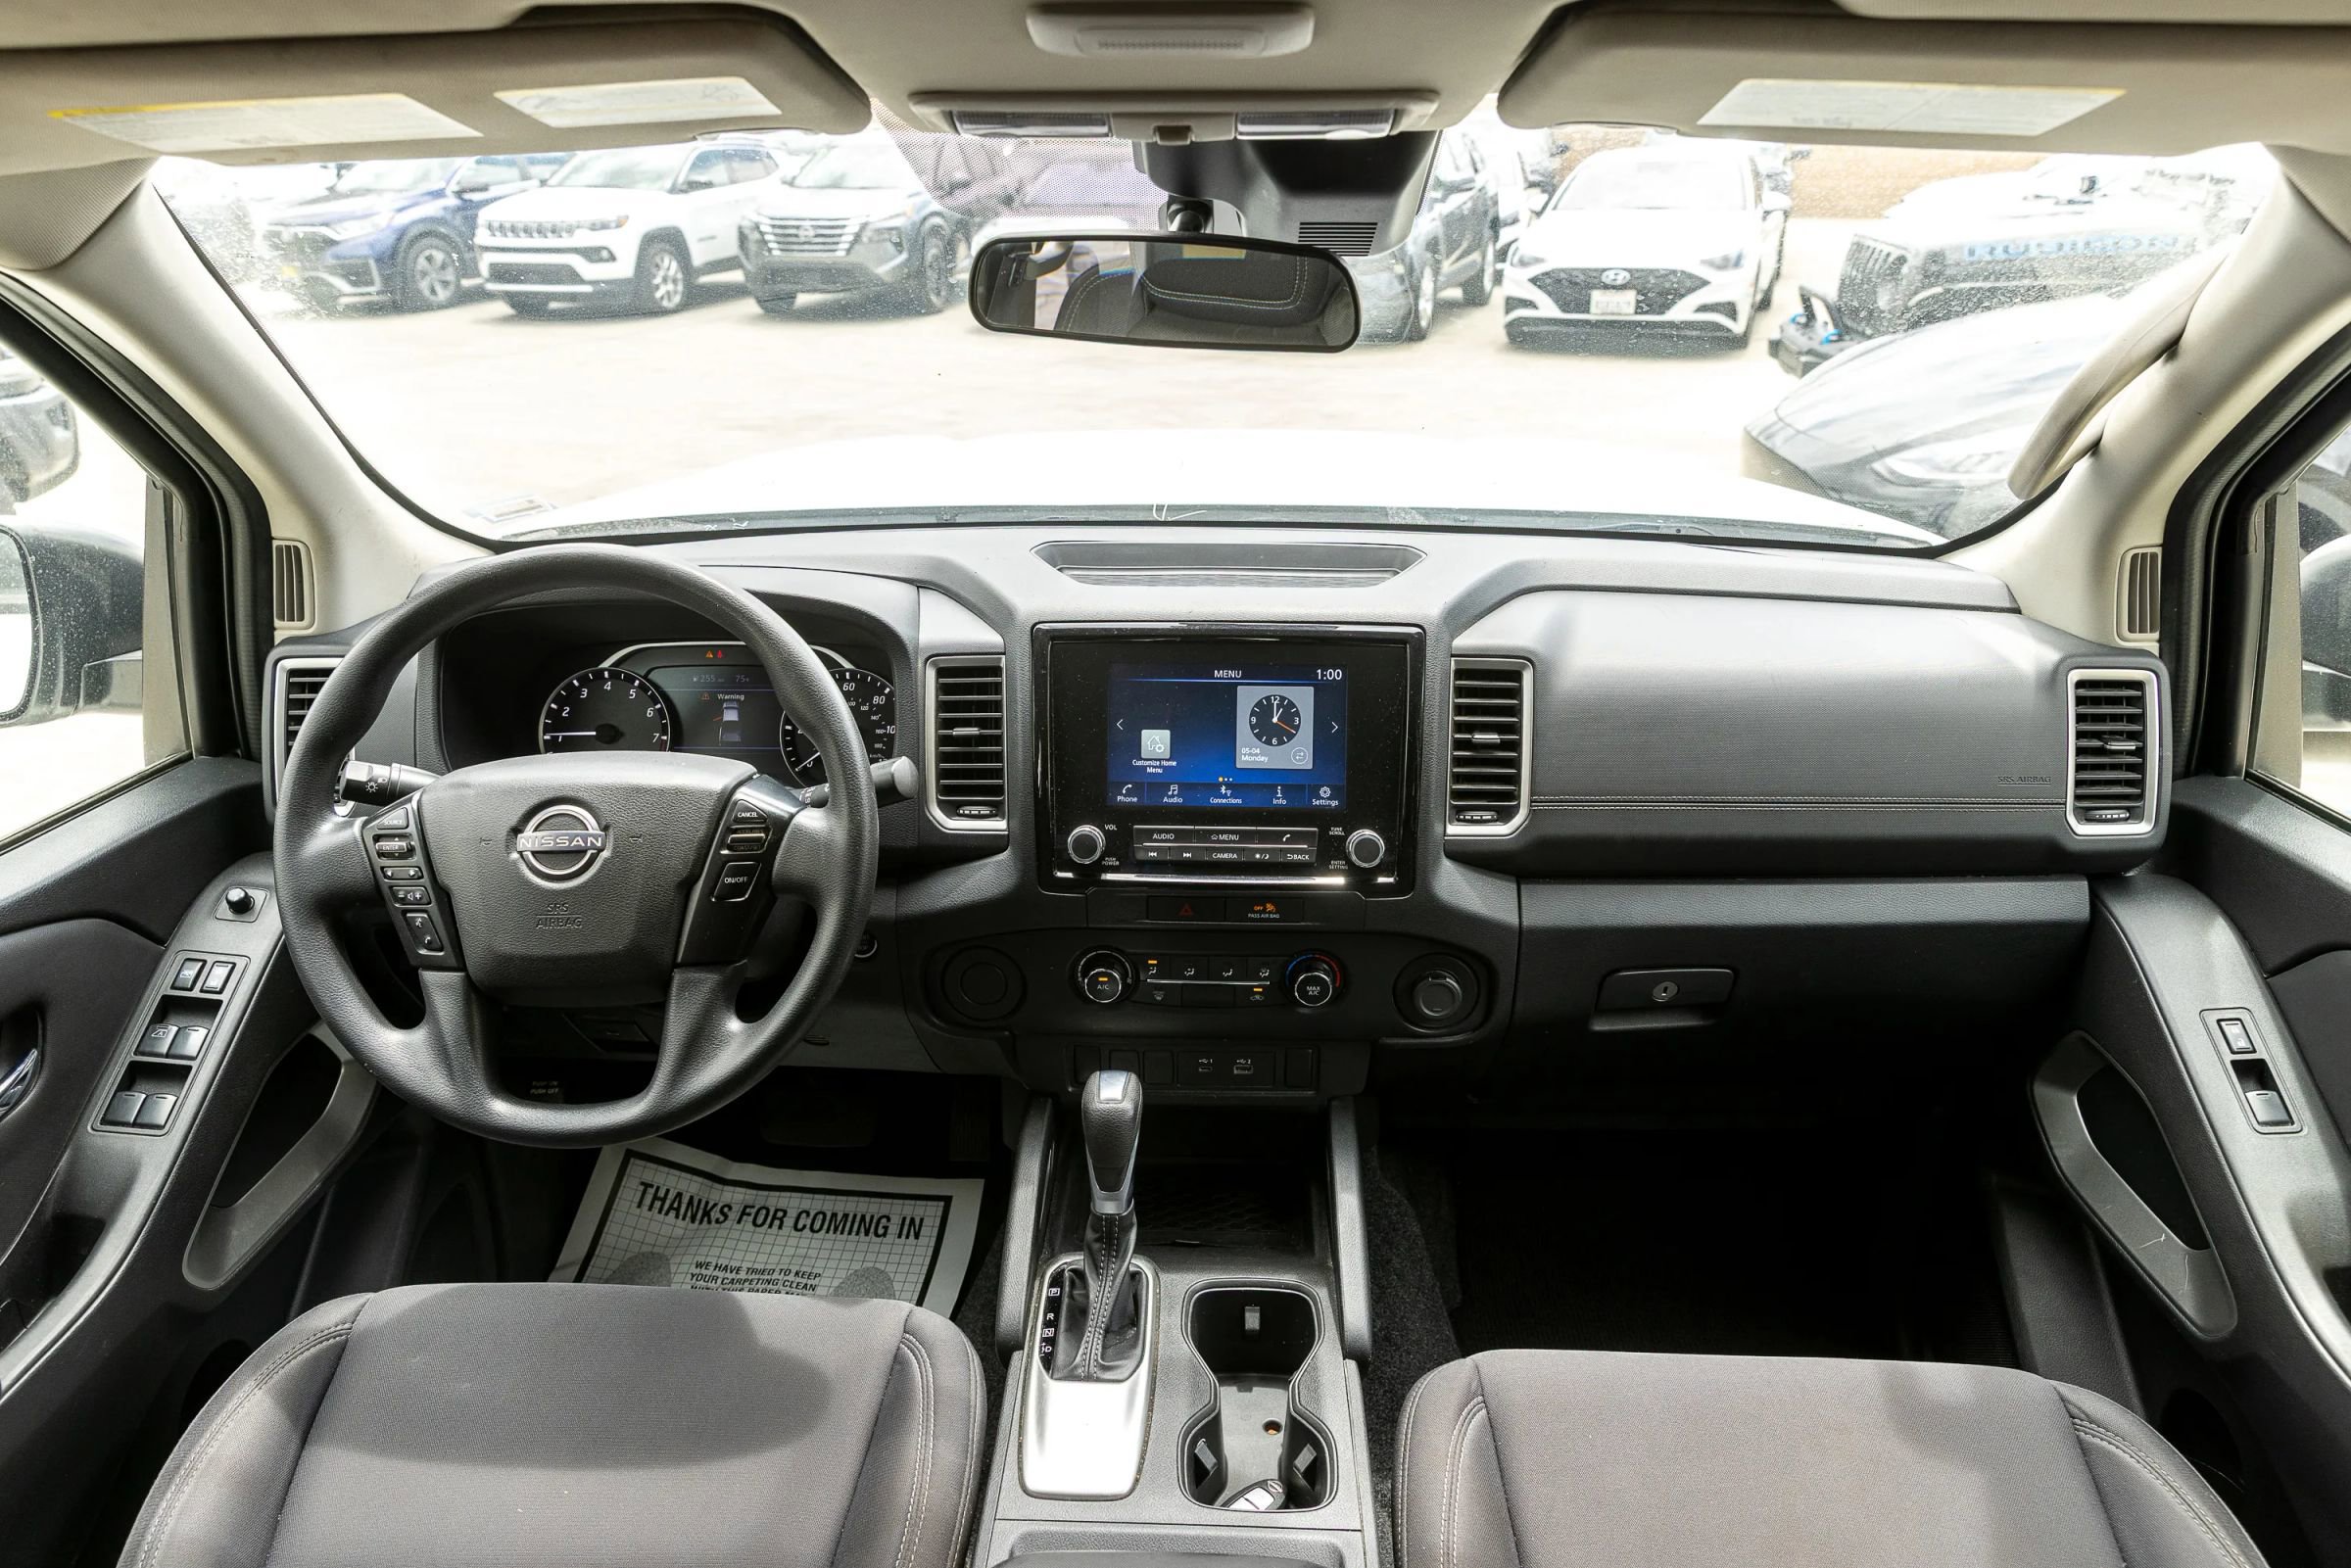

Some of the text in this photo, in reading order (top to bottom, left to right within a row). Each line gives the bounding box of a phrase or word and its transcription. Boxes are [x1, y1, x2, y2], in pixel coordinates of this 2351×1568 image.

[1214, 669, 1242, 679] MENU
[1316, 669, 1342, 681] 1:00
[603, 681, 611, 690] 4
[842, 682, 855, 691] 60
[580, 688, 588, 698] 3
[629, 689, 637, 699] 5
[873, 695, 886, 704] 80
[562, 706, 570, 717] 2
[647, 707, 654, 717] 6
[1251, 716, 1256, 725] 9
[886, 726, 896, 735] 10
[652, 734, 659, 742] 7
[1241, 754, 1269, 763] Monday
[1312, 798, 1339, 807] Settings
[519, 836, 601, 848] NISSAN
[548, 903, 569, 915] SRS
[536, 918, 583, 929] AIRBAG
[637, 1181, 925, 1240] THANKS FOR COMING IN
[695, 1260, 822, 1281] WE HAVE TRIED TO KEEP
[690, 1273, 818, 1292] YOUR CARPETING CLEAN
